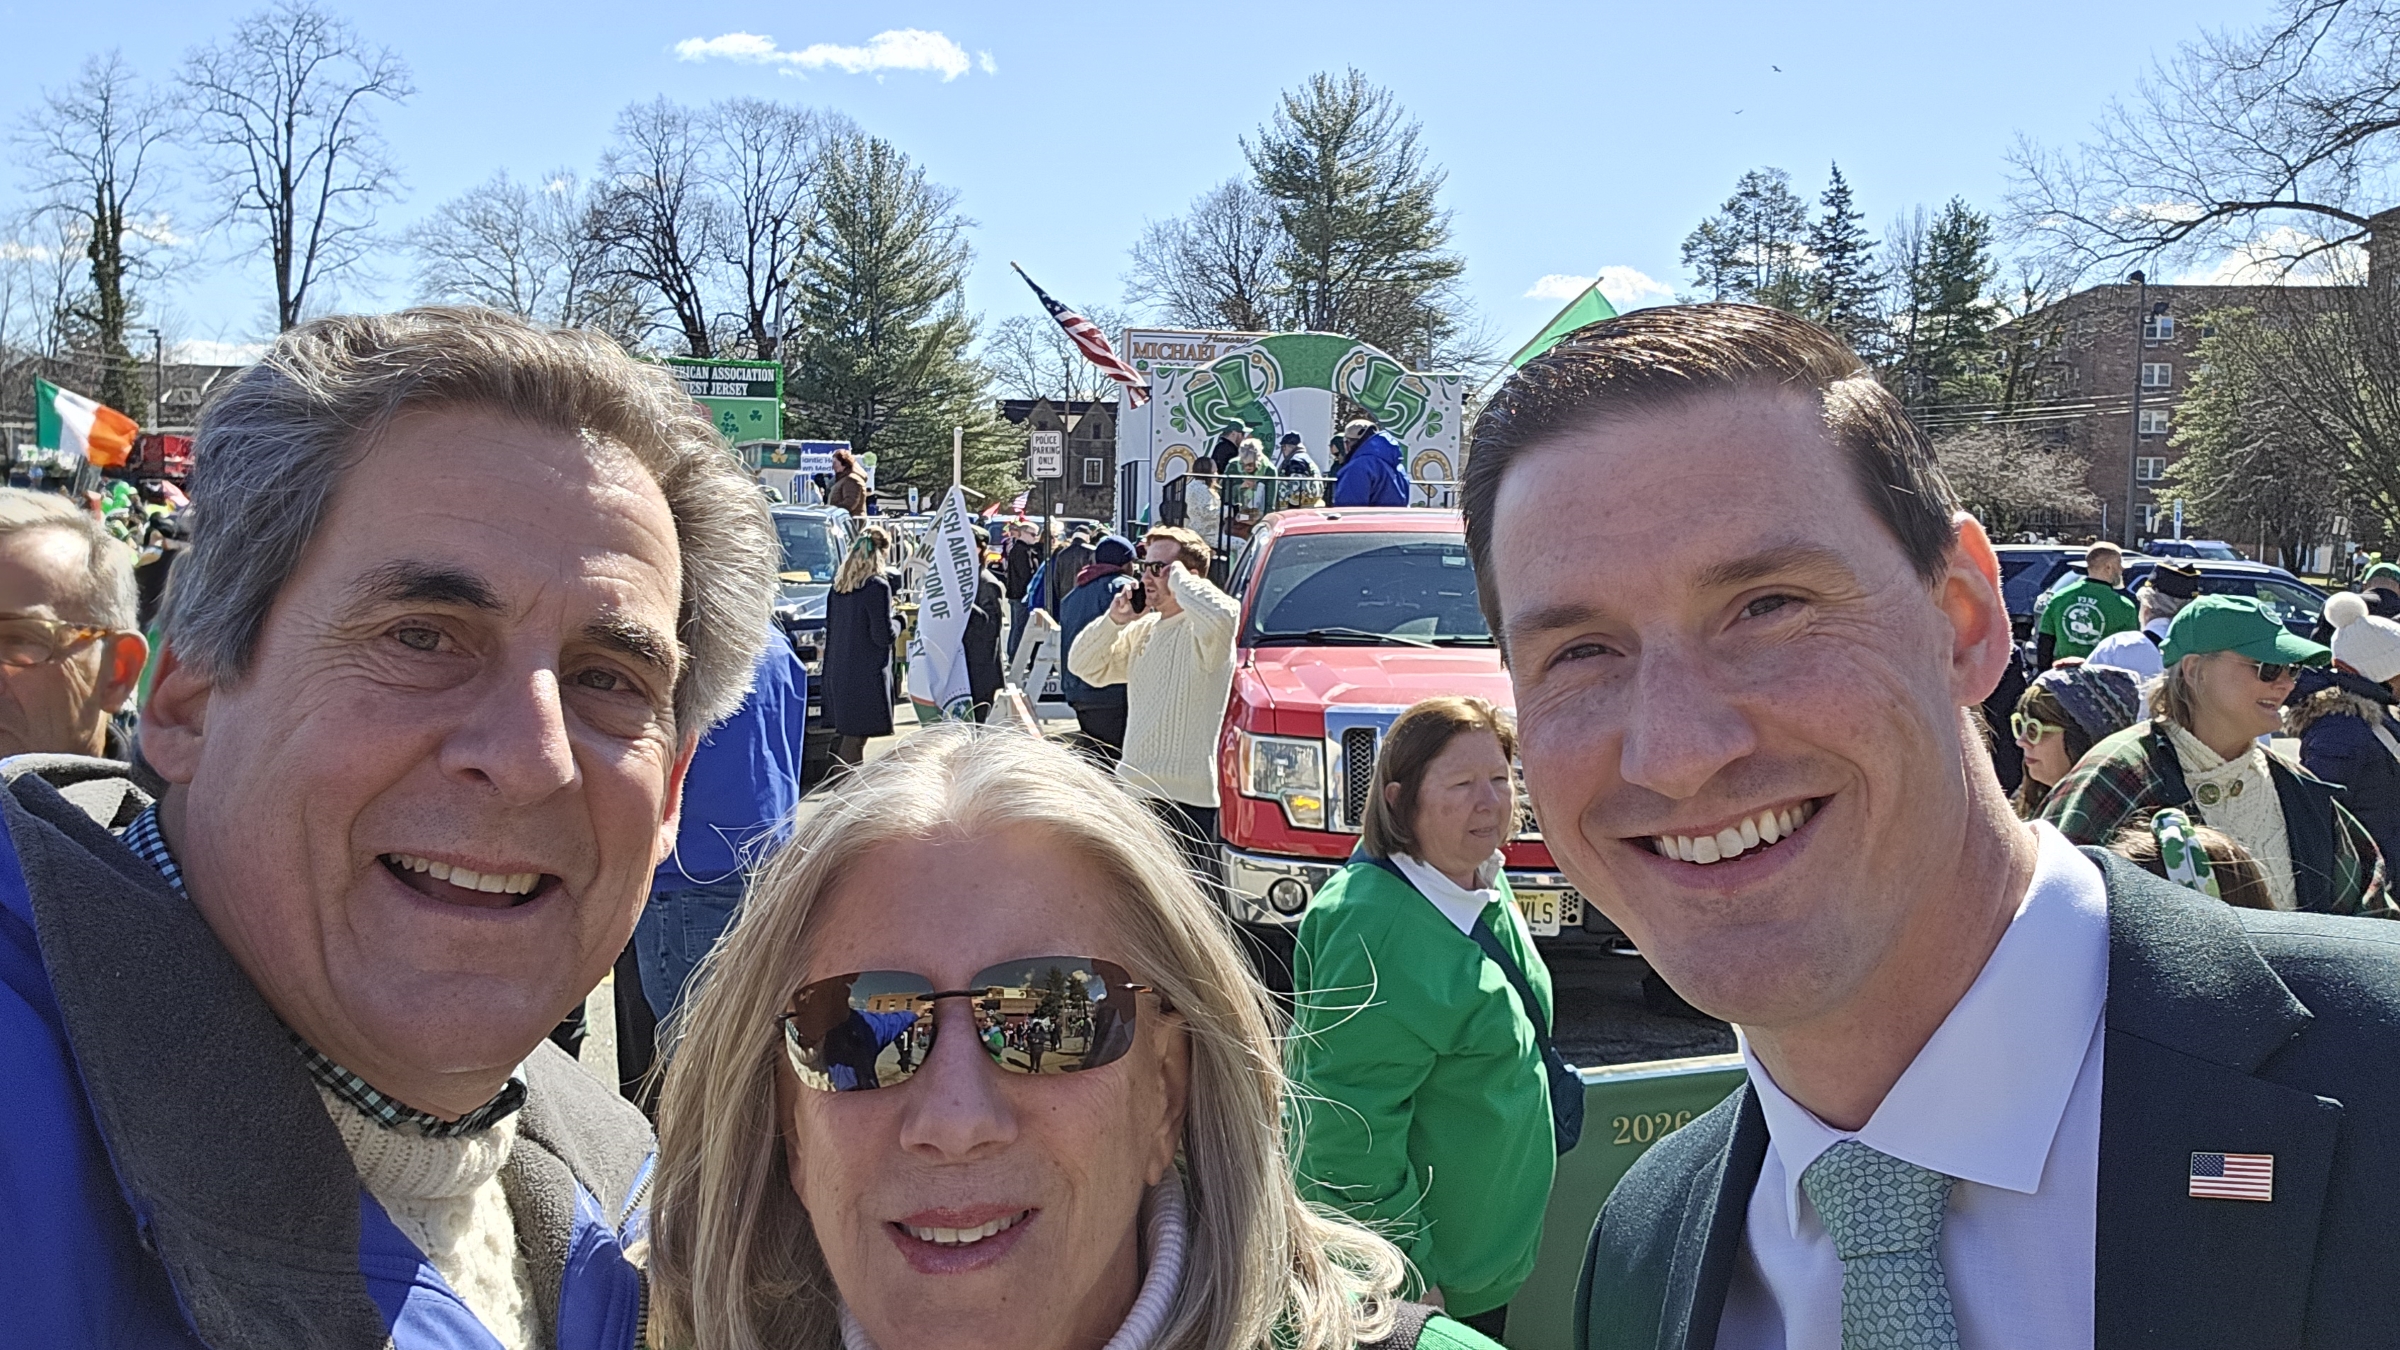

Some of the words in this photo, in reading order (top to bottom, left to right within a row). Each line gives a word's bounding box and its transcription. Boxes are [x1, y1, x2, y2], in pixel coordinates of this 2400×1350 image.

[1132, 342, 1216, 361] MICHAEL
[711, 367, 775, 382] ASSOCIATION
[710, 382, 749, 396] JERSEY
[1035, 436, 1057, 444] POLICE
[1033, 446, 1060, 454] PARKING
[1038, 456, 1054, 465] ONLY
[946, 537, 974, 614] AMERICAN
[930, 601, 950, 620] OF
[1612, 1110, 1691, 1145] 2026
